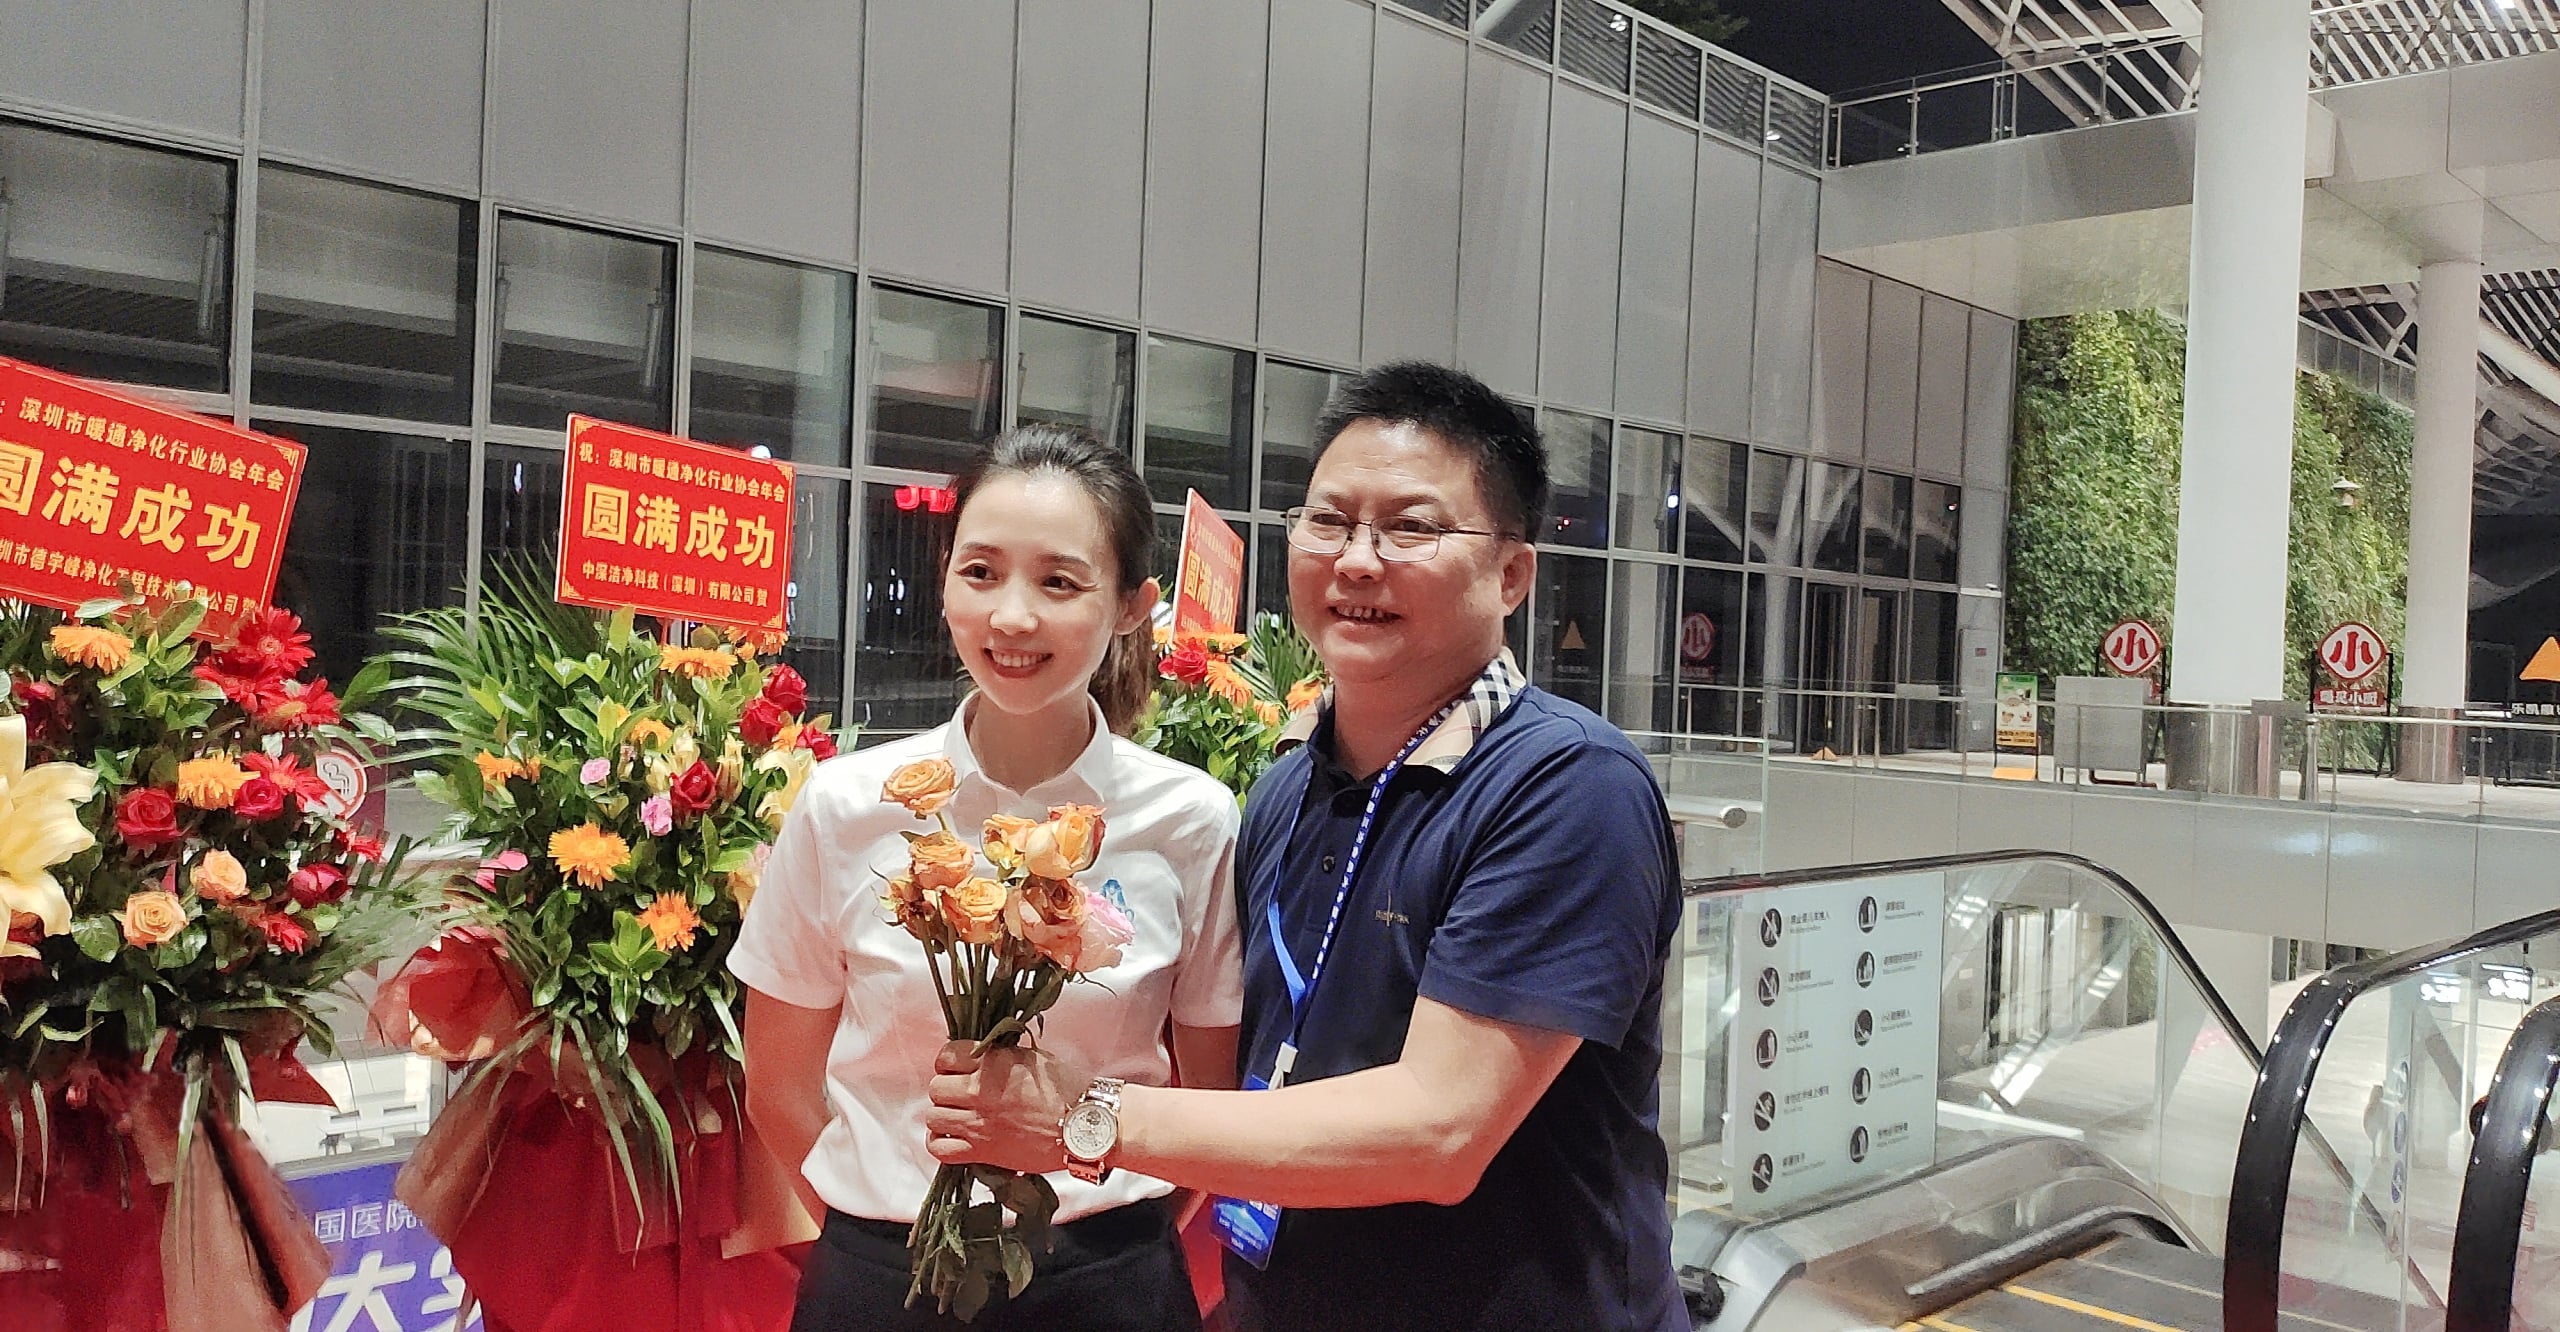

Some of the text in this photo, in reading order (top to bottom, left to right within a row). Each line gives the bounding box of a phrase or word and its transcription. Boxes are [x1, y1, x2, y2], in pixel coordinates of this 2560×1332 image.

[0, 438, 261, 569] 圆满成功
[582, 483, 775, 569] 圆满成功
[2111, 628, 2149, 666] 小
[2329, 631, 2374, 672] 小
